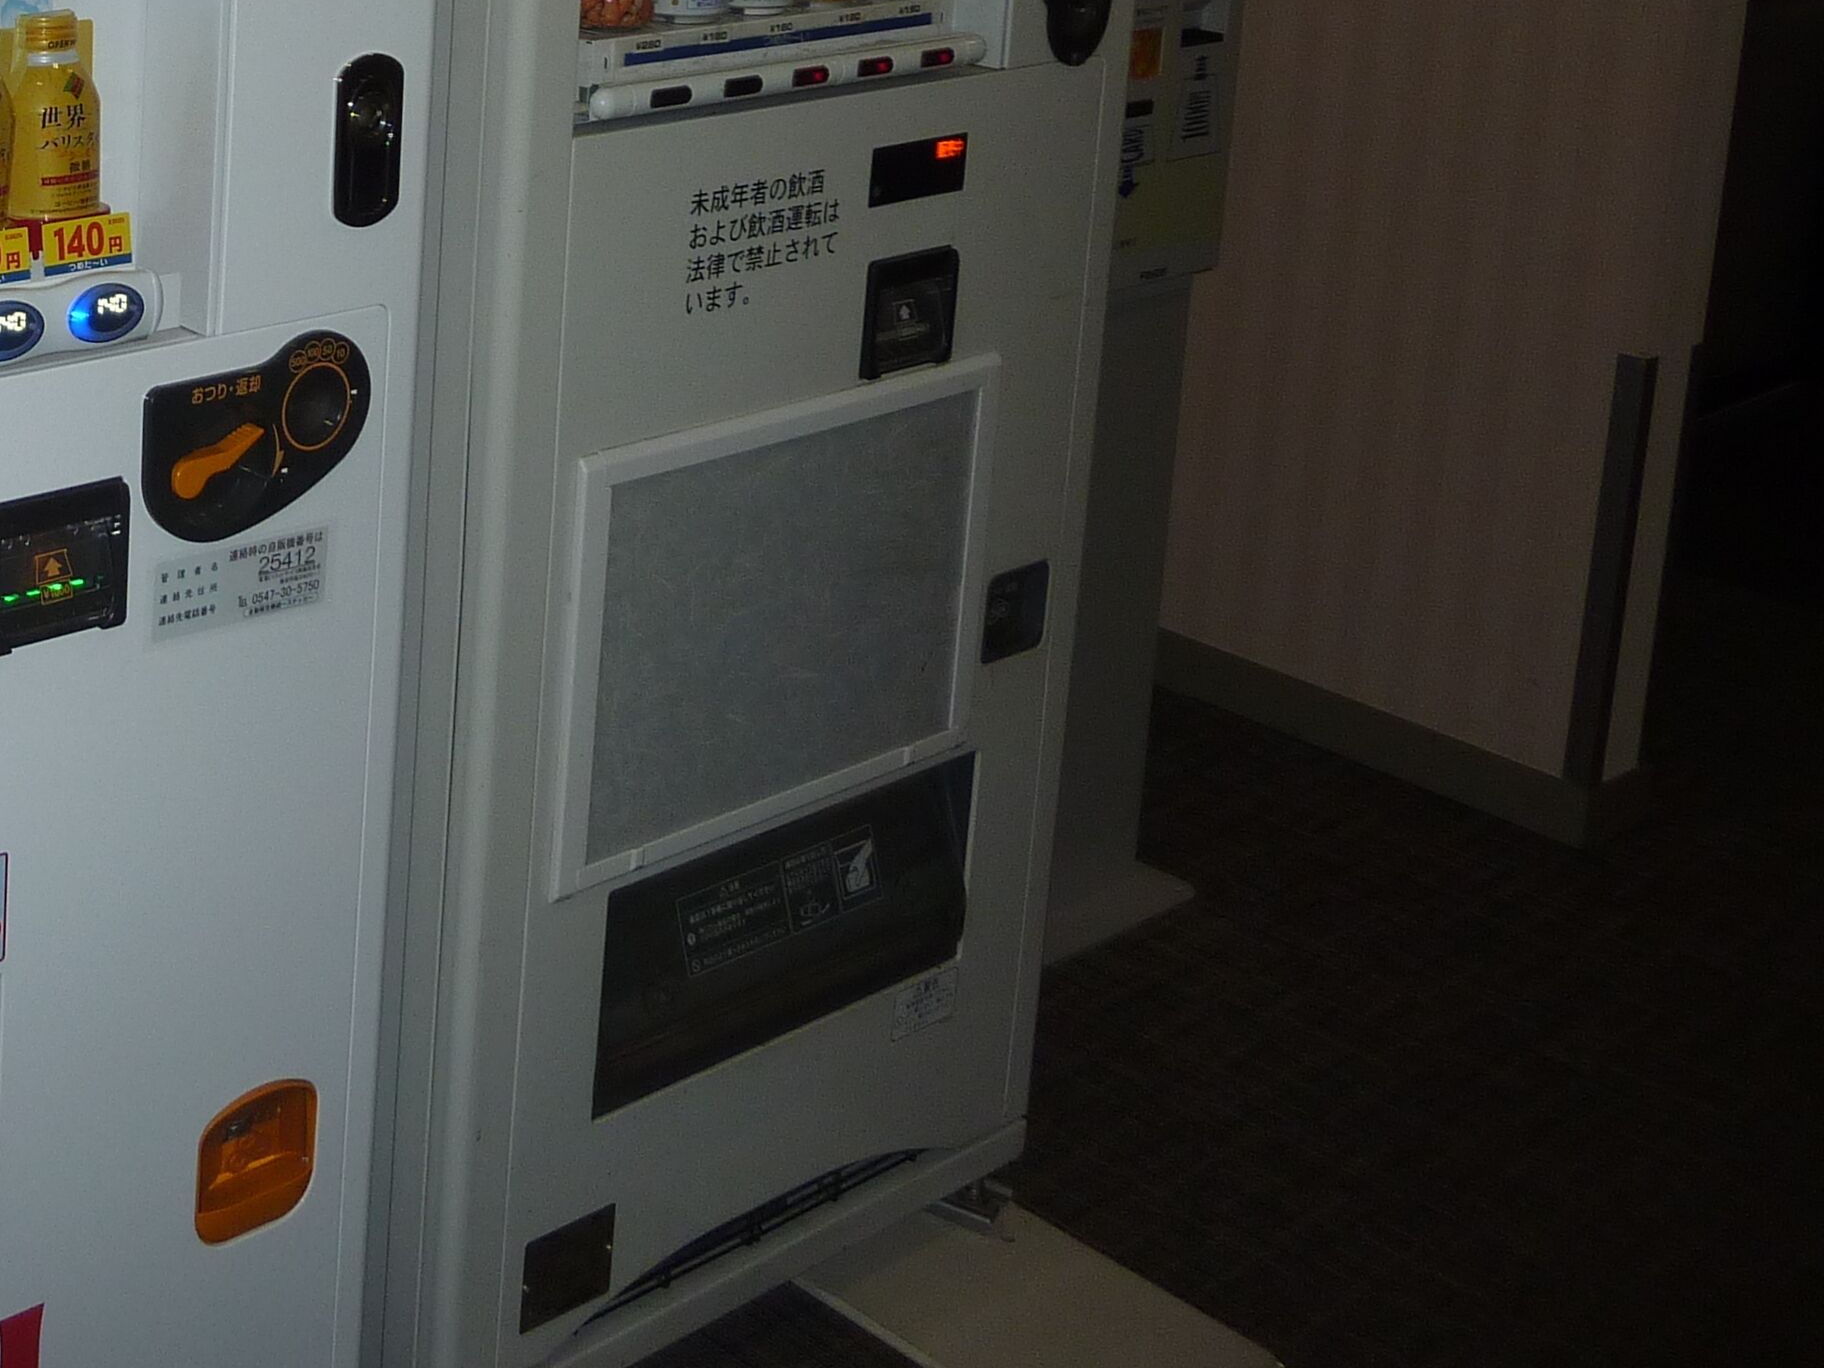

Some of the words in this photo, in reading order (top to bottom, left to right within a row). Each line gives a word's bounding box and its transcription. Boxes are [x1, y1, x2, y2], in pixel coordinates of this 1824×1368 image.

[689, 169, 826, 218] 未成年者の飲酒
[688, 201, 840, 250] および飲酒運転は
[686, 232, 839, 284] 法律で禁止されて
[97, 293, 127, 314] 140
[685, 283, 750, 315] います。
[190, 375, 262, 405] おつり・返却
[258, 546, 317, 574] 25412
